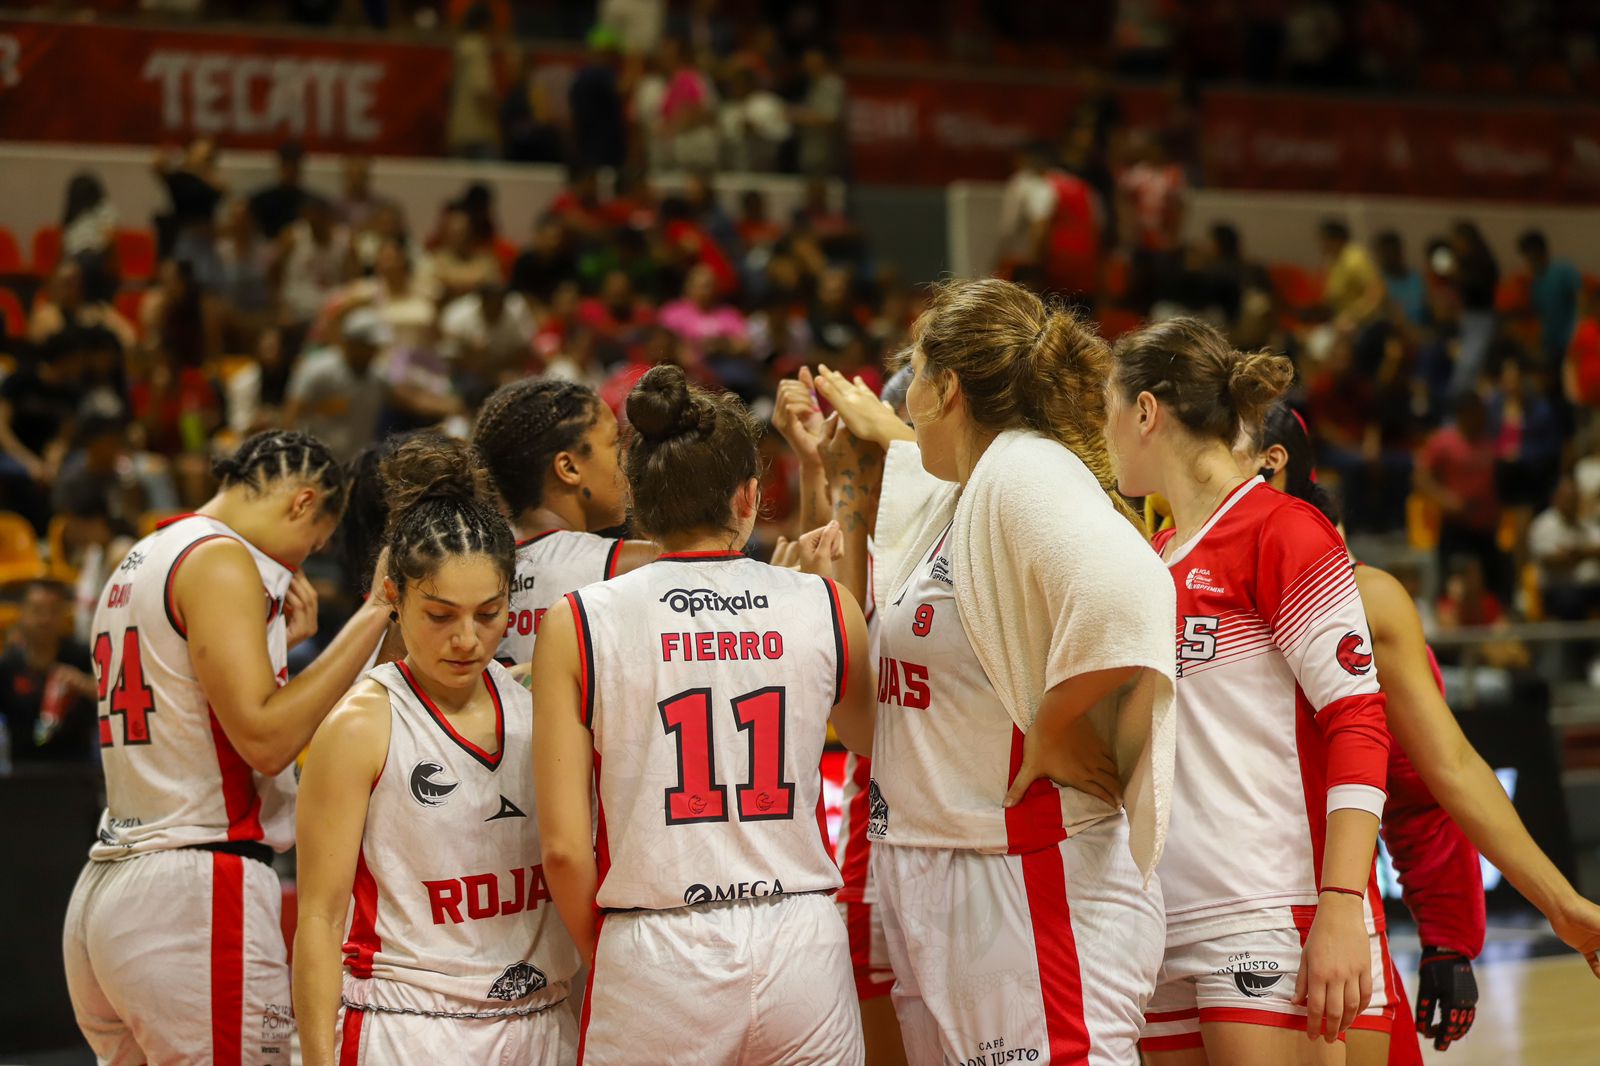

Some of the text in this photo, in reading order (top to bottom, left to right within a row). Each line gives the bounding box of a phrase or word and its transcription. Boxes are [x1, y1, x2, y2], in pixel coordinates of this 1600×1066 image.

[144, 50, 386, 140] TECATE
[660, 588, 769, 617] Optixala
[912, 604, 935, 637] 9
[661, 631, 784, 662] FIERRO
[93, 626, 156, 748] 24
[878, 656, 931, 710] JAS
[657, 686, 796, 826] 11
[684, 879, 784, 904] OMEGA
[1238, 961, 1279, 975] JUSTO
[979, 1037, 1005, 1051] CAFÉ
[991, 1048, 1039, 1065] JUSTO
